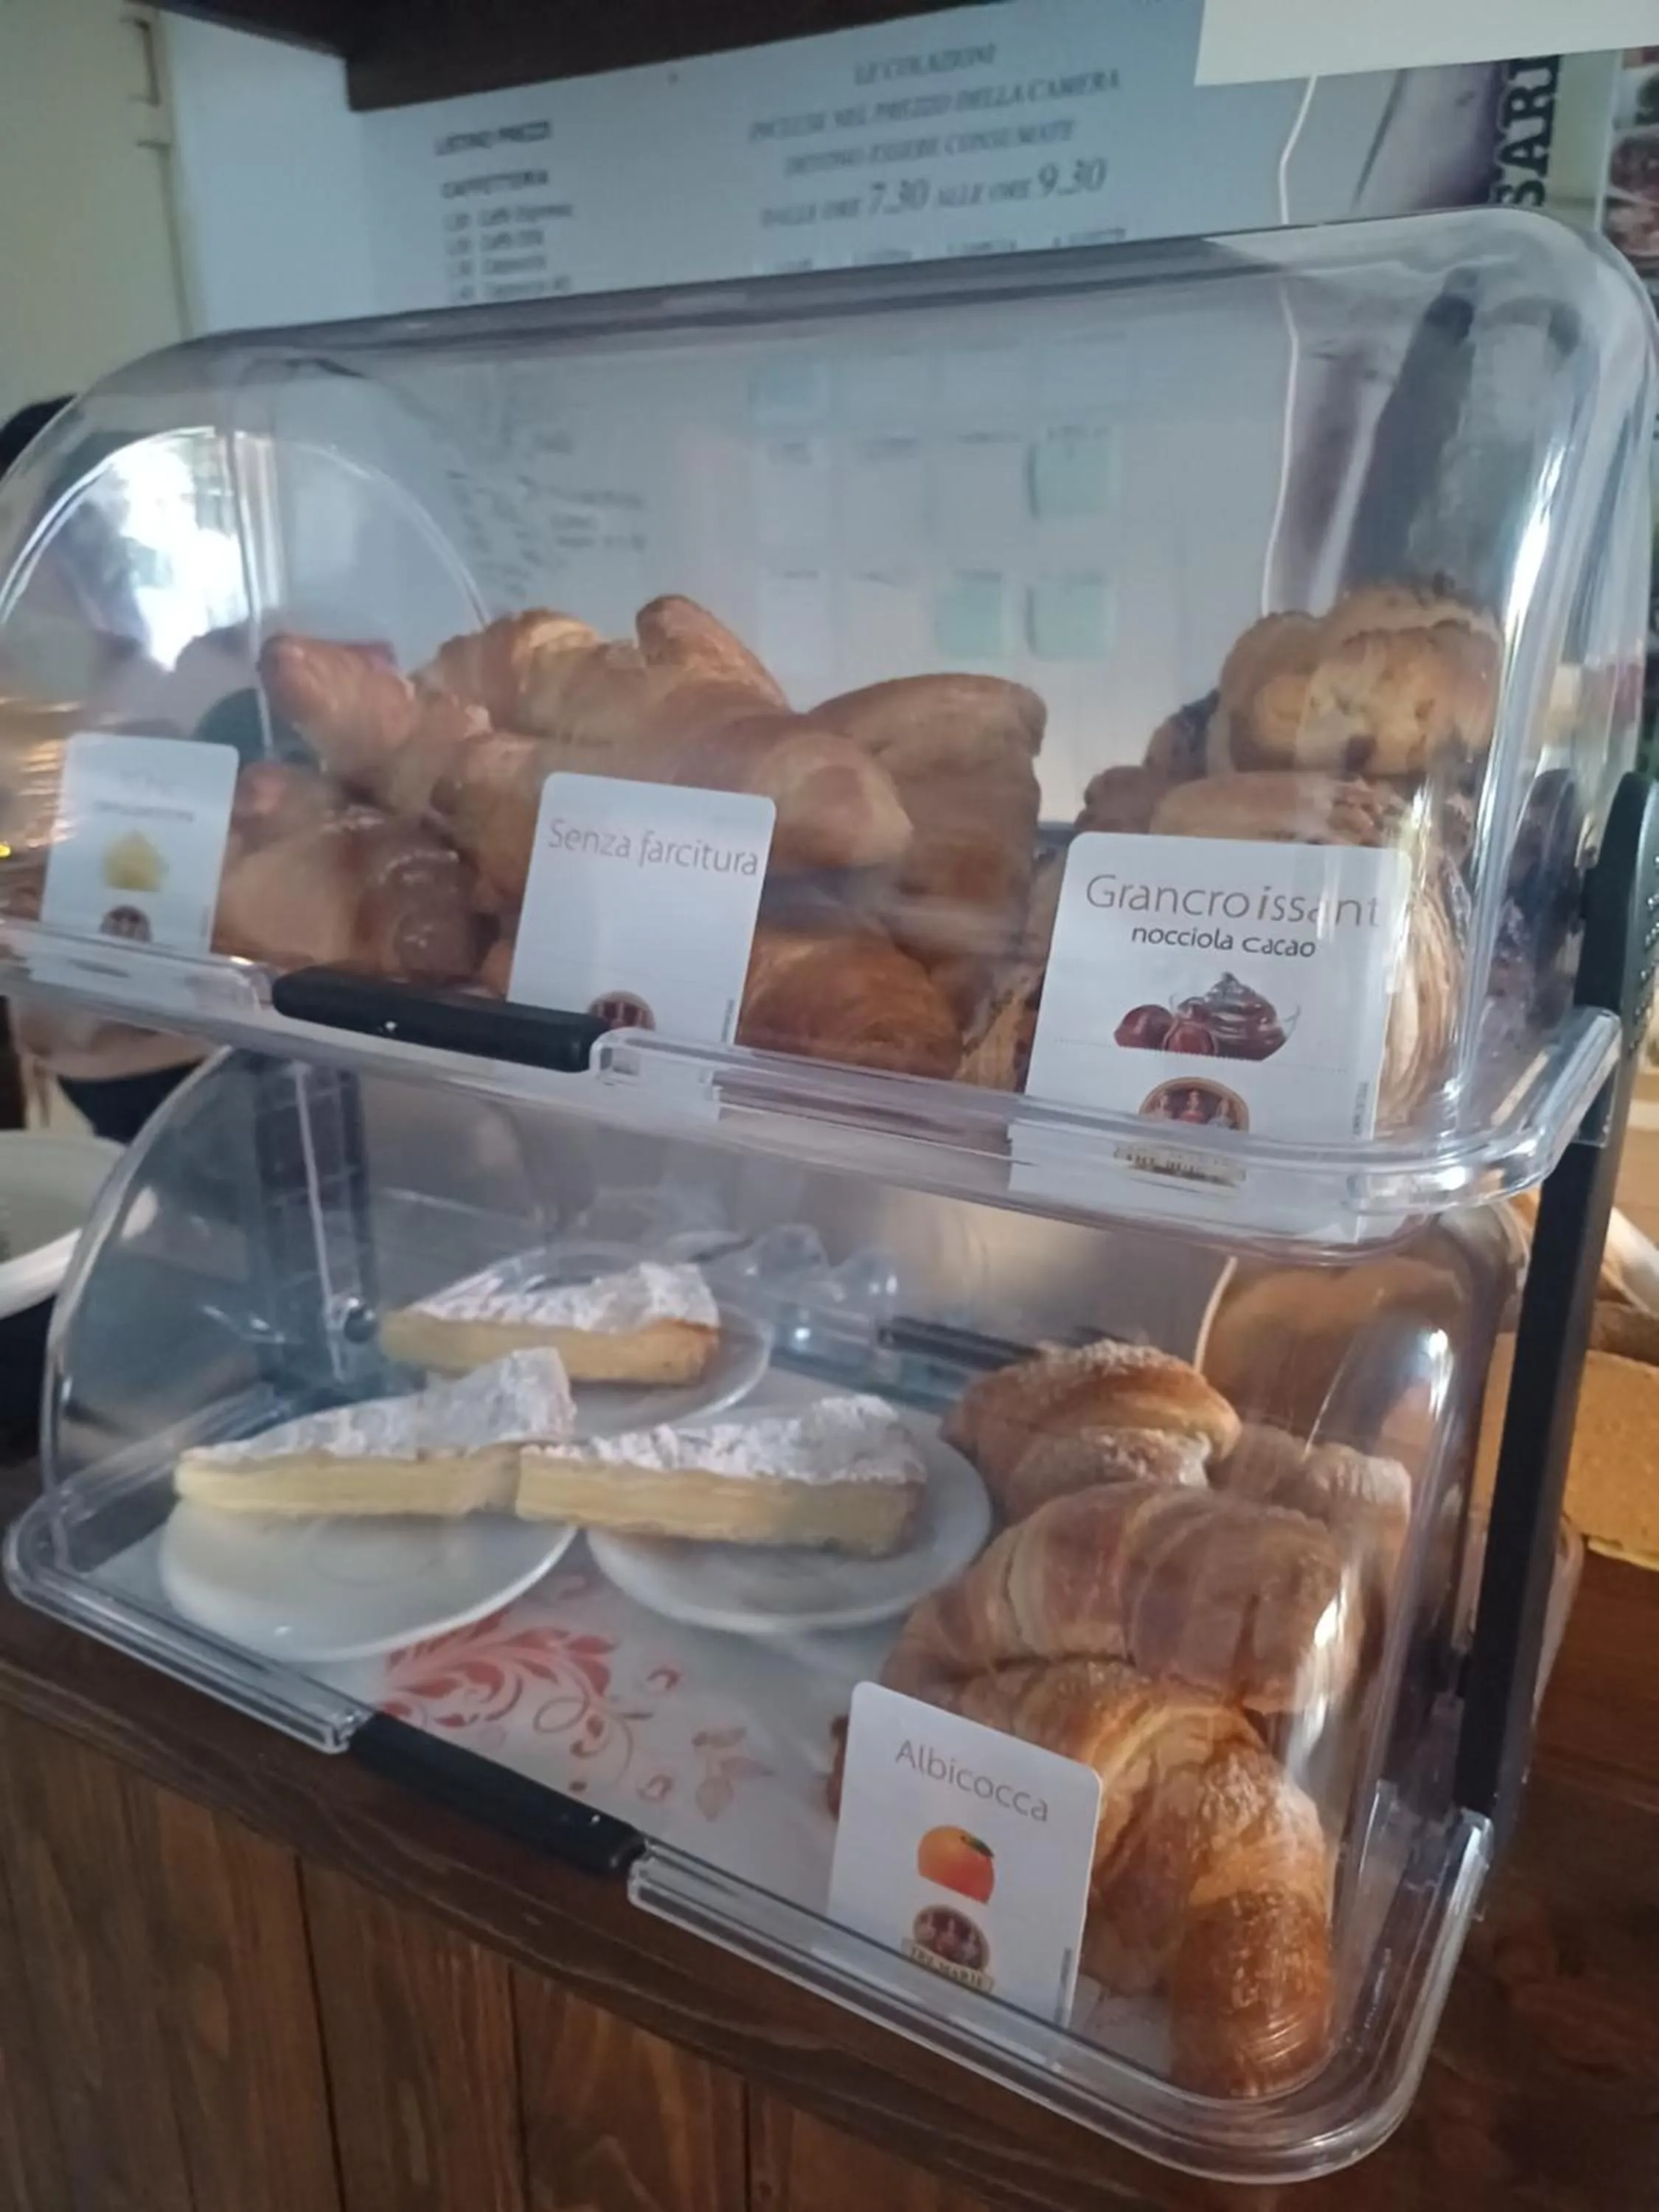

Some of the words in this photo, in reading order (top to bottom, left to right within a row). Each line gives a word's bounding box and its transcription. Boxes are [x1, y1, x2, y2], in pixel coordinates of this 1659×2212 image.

[547, 817, 632, 859] Senza
[638, 830, 759, 876] farcitura
[1131, 925, 1234, 952] nocciola
[1242, 935, 1317, 959] cacao
[894, 1739, 1049, 1823] Albicocca
